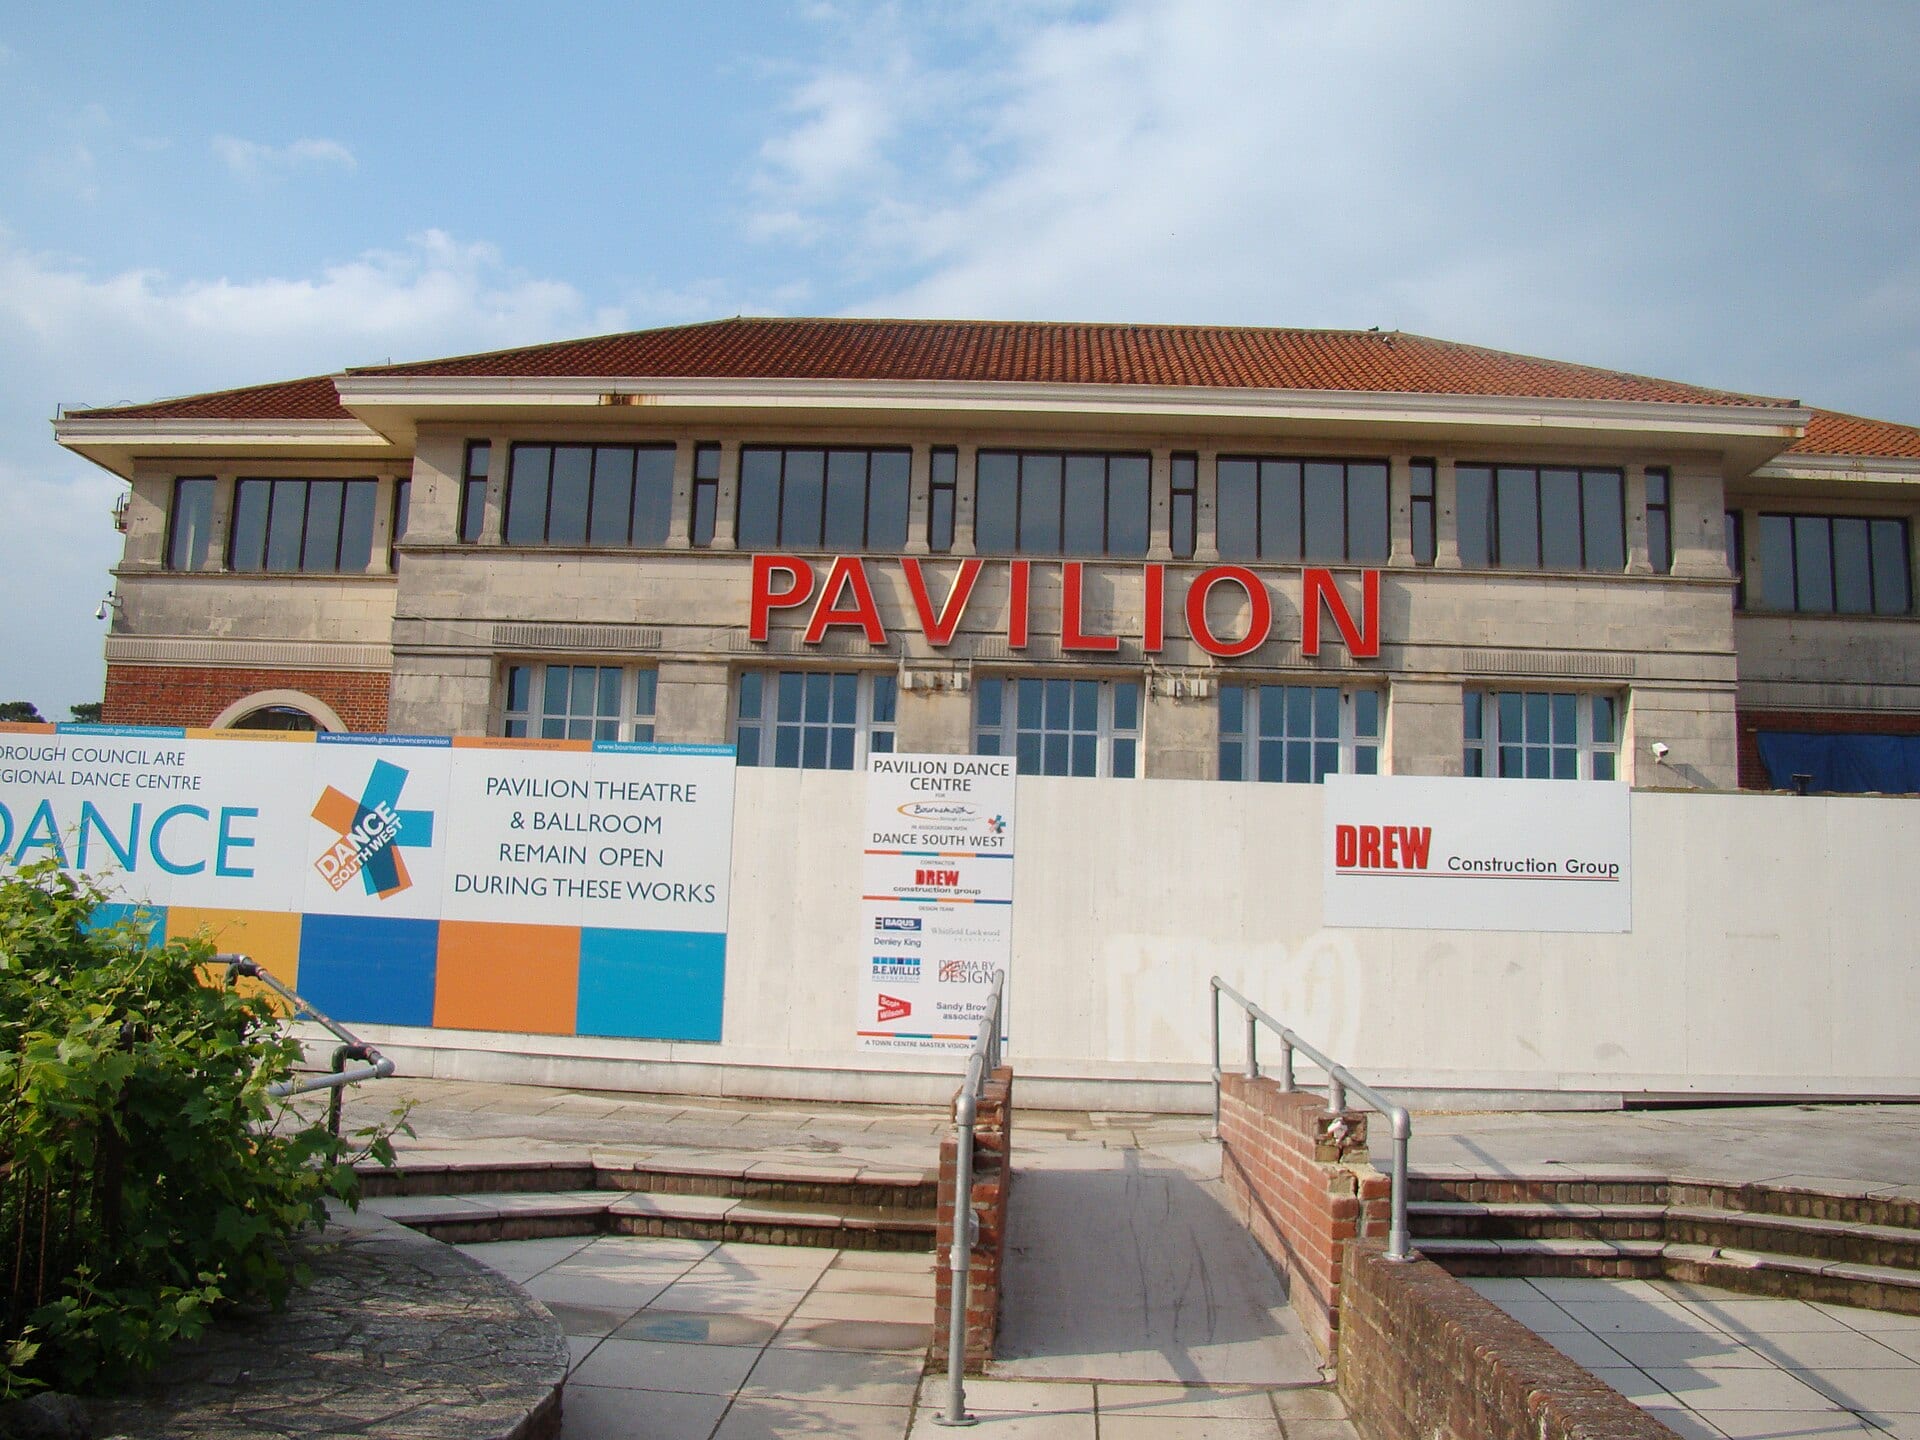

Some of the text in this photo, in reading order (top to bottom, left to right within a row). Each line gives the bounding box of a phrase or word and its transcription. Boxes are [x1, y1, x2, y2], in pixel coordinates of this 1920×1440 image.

[749, 554, 1381, 659] PAVILION
[0, 746, 186, 767] ROUGH COUNCIL ARE
[873, 760, 1010, 776] PAVILION DANCE
[71, 771, 131, 788] DANCE
[135, 774, 201, 791] CENTRE
[485, 776, 698, 803] PAVILION THEATRE
[910, 777, 972, 792] CENTRE
[510, 812, 662, 835] & BALLROOM
[316, 800, 398, 879] DANCE
[872, 833, 1005, 847] DANCE SOUTH WEST
[1335, 824, 1432, 870] DREW
[331, 816, 403, 888] SOUTH WEST
[499, 843, 664, 868] REMAIN OPEN
[1447, 856, 1620, 878] Construction Group
[915, 869, 960, 886] DREW
[454, 873, 717, 903] DURING THESE WORKS
[893, 886, 981, 895] construction group
[884, 918, 915, 929] BAQUS
[873, 937, 922, 948] Denley King
[872, 965, 920, 975] B.E.WILLIS
[938, 959, 995, 971] DRAMA BY
[938, 970, 994, 984] DESIGN
[936, 1001, 963, 1012] Sandy
